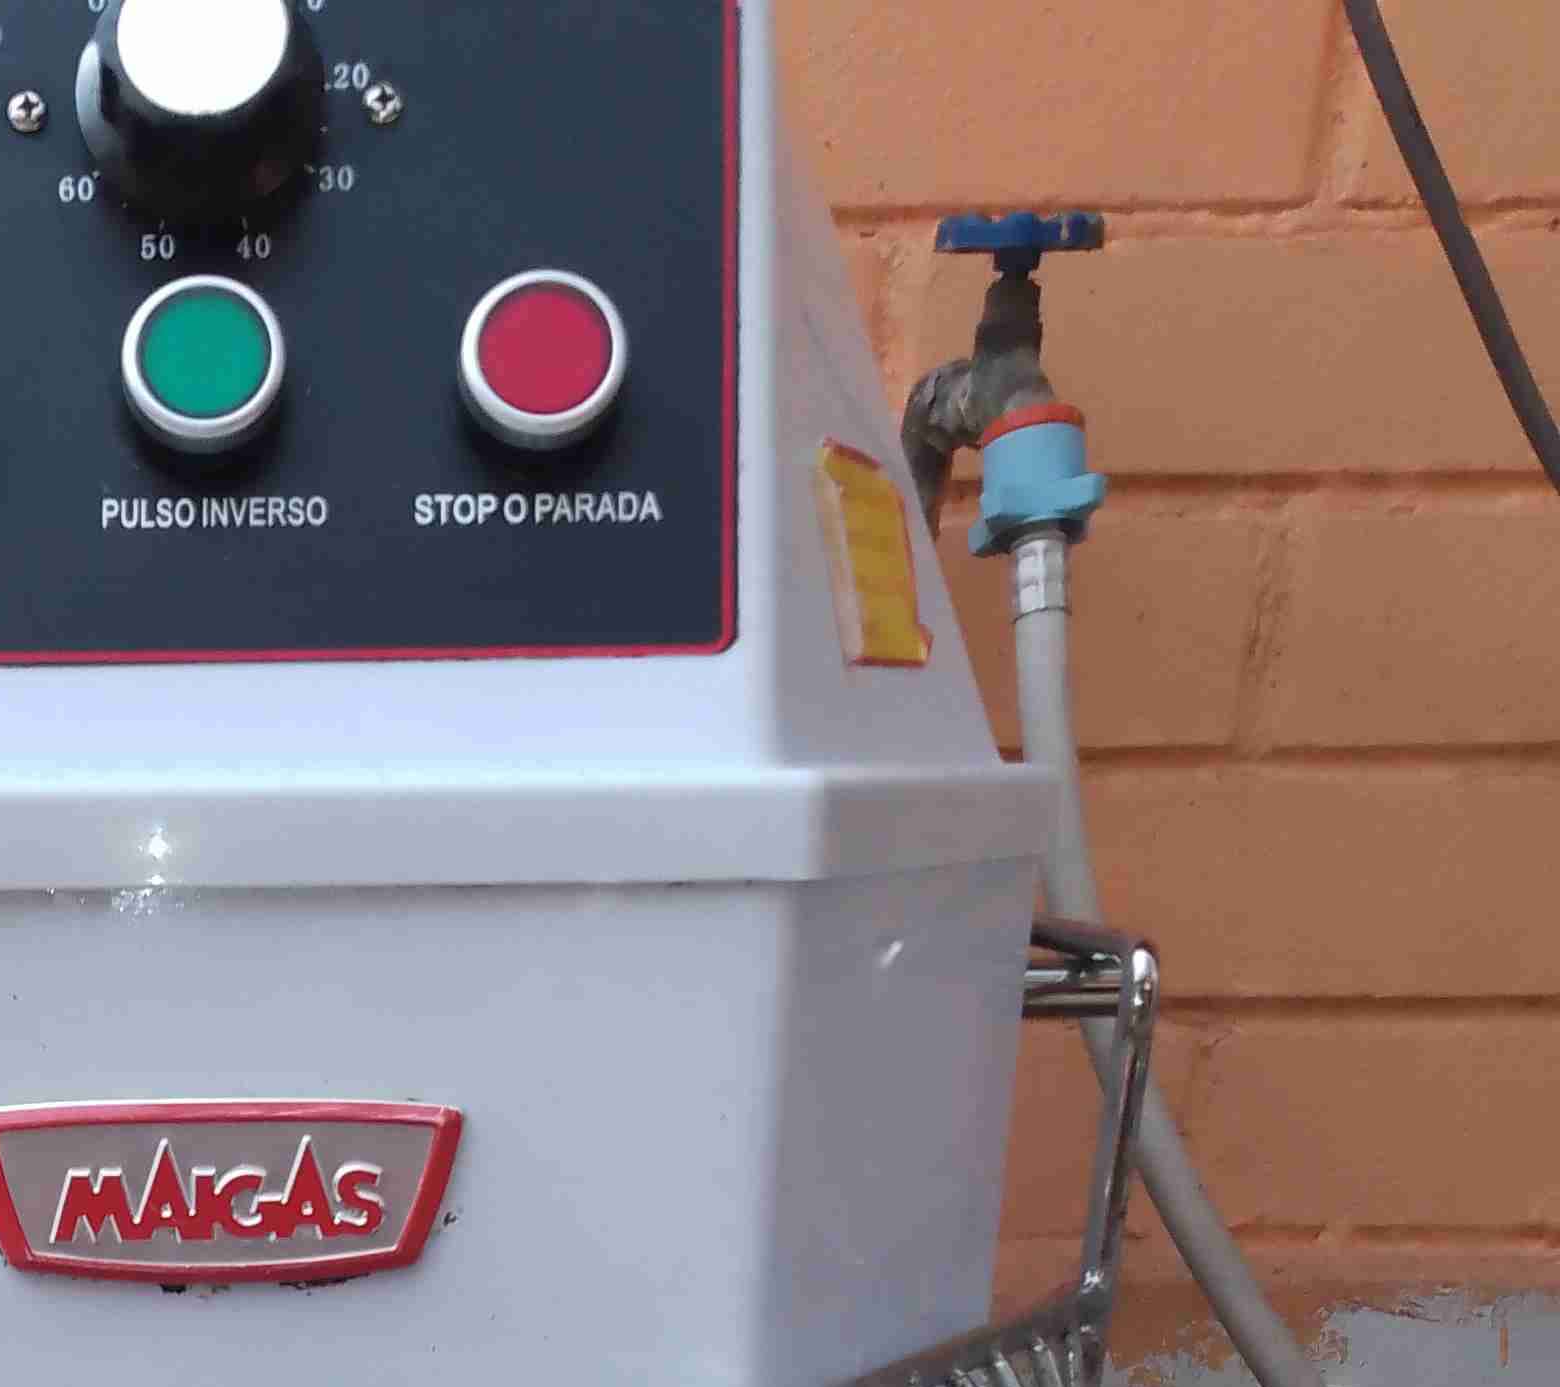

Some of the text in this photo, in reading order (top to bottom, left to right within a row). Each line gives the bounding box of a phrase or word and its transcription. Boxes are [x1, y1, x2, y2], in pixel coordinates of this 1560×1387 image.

[333, 62, 370, 90] 20
[58, 175, 95, 203] 60
[318, 164, 355, 192] 30
[140, 233, 176, 260] 50
[237, 233, 272, 259] 40
[102, 495, 328, 529] PULSO INVERSO
[414, 490, 662, 525] STOP O PARADA
